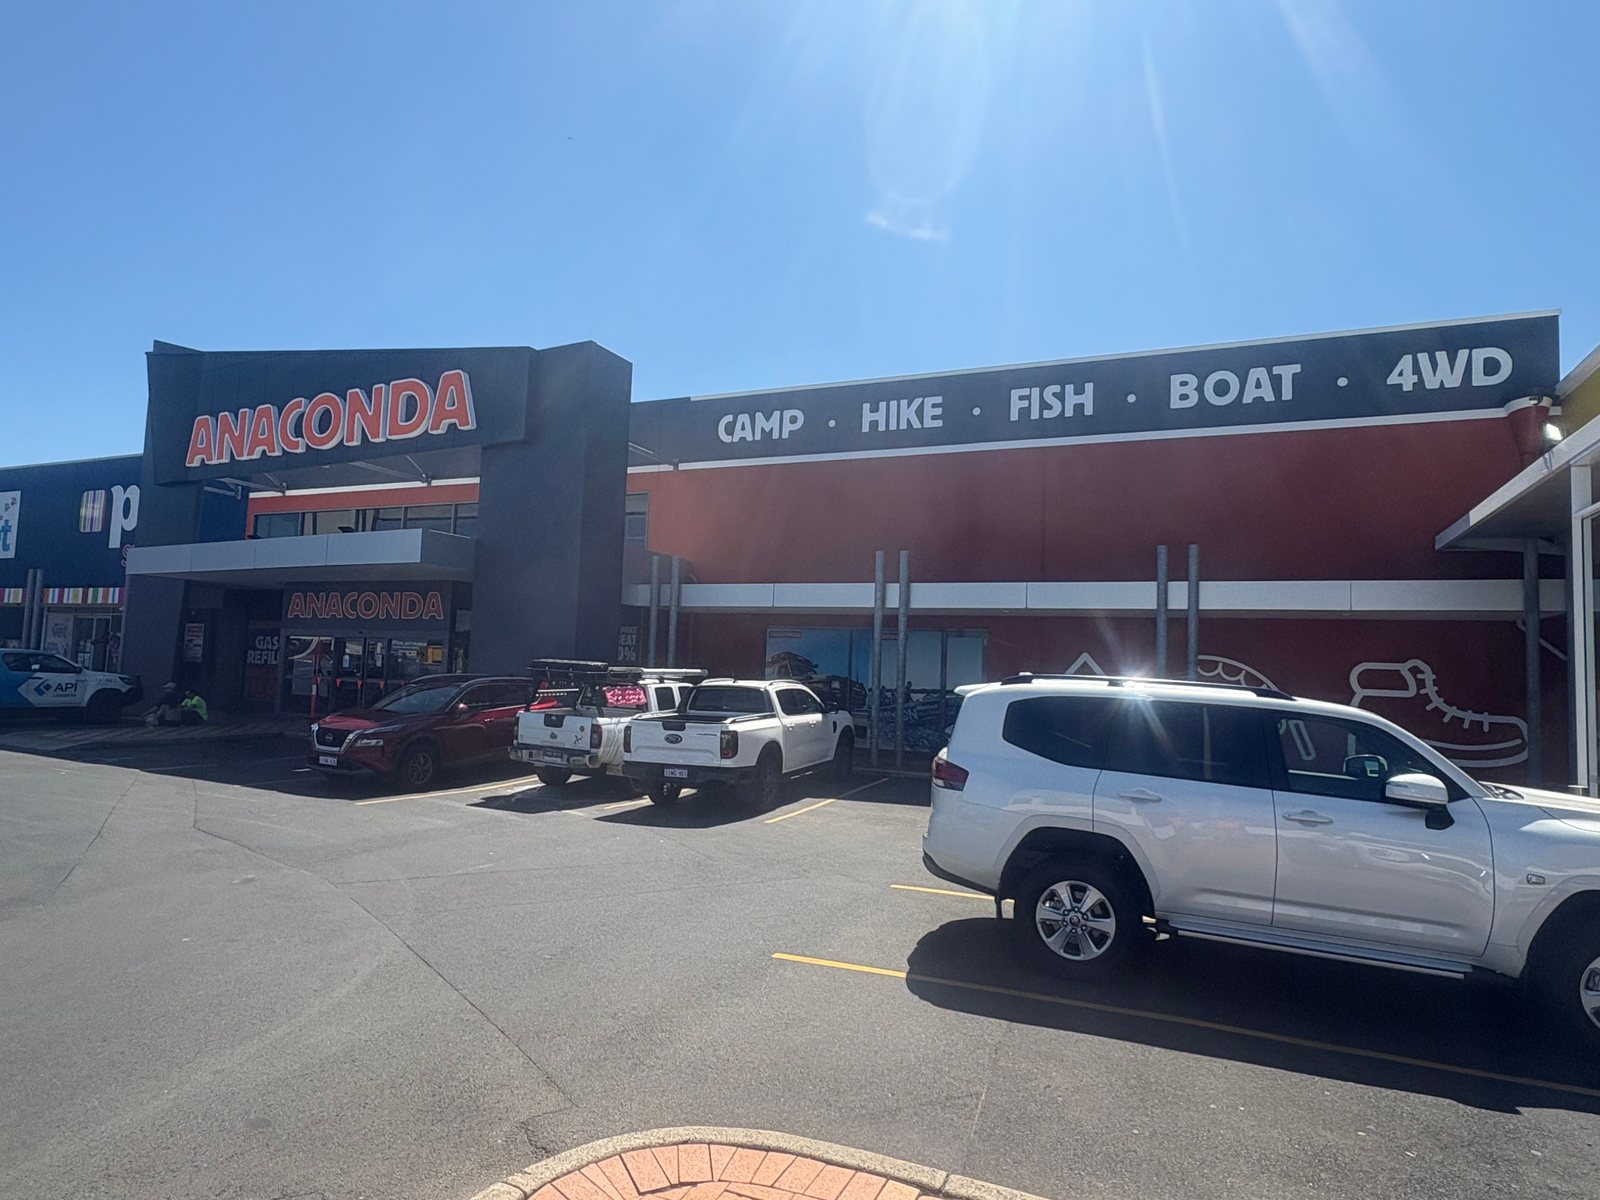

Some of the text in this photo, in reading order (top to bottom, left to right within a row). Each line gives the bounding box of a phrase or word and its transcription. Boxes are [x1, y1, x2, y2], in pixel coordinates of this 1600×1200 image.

[717, 346, 1513, 443] CAMP HIKE FISH BOAT 4WD
[185, 369, 477, 468] ANACONDA
[287, 591, 444, 620] ANACONDA
[255, 635, 279, 650] GAS
[617, 646, 637, 661] 0%
[54, 682, 78, 693] API
